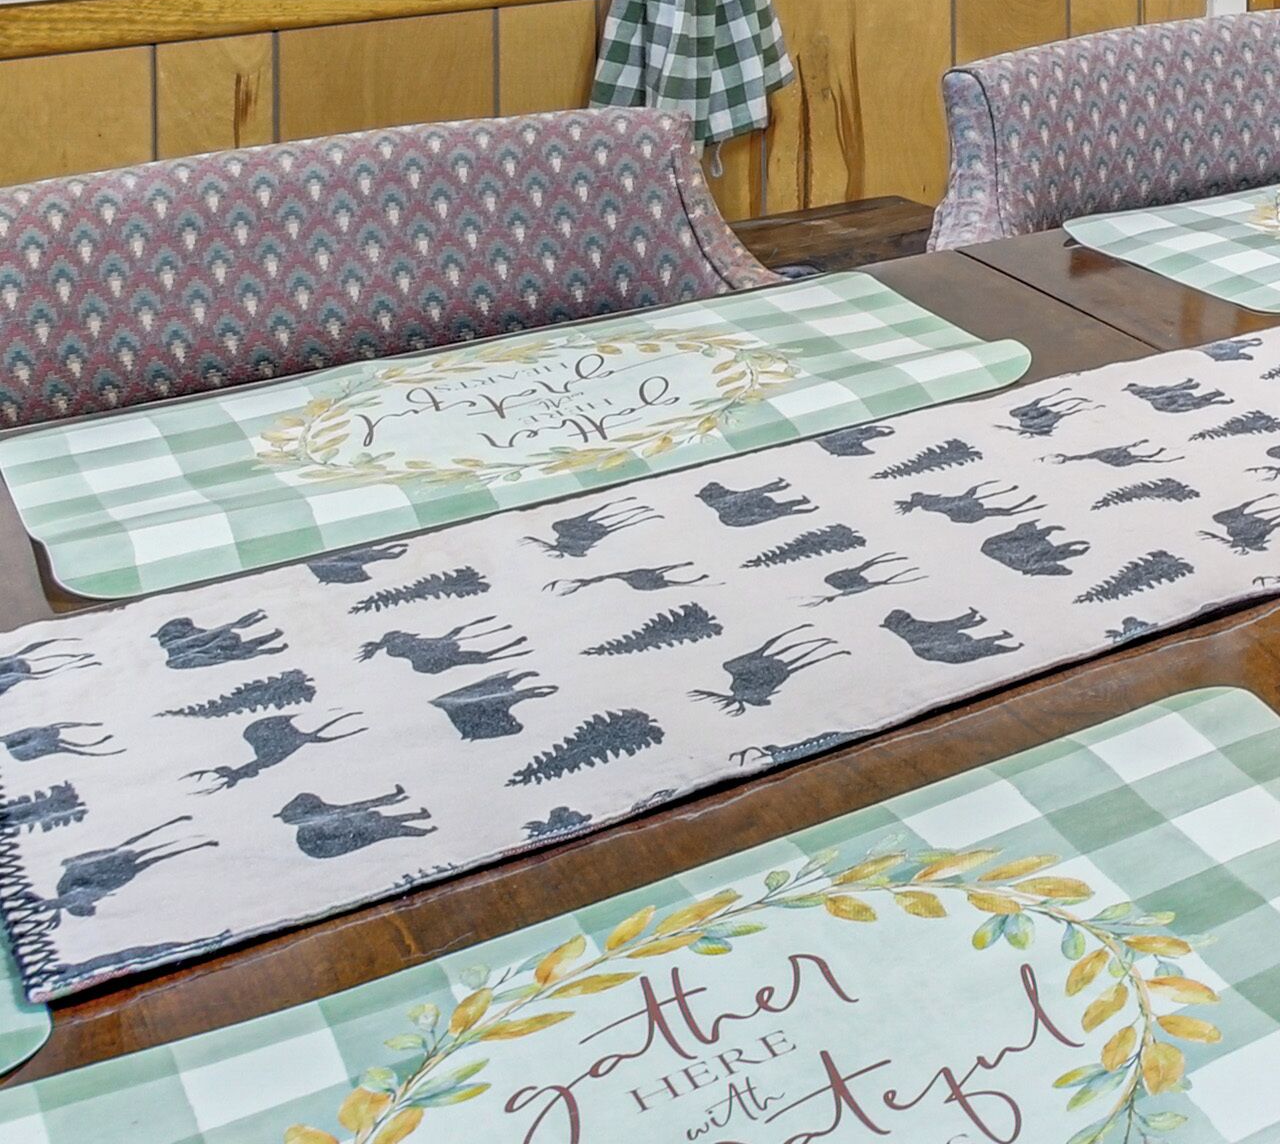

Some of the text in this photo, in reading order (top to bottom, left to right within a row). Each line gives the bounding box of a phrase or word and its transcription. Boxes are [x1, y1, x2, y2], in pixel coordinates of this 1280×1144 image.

[504, 953, 860, 1144] gather
[627, 1029, 797, 1114] HERE
[686, 1076, 786, 1141] with
